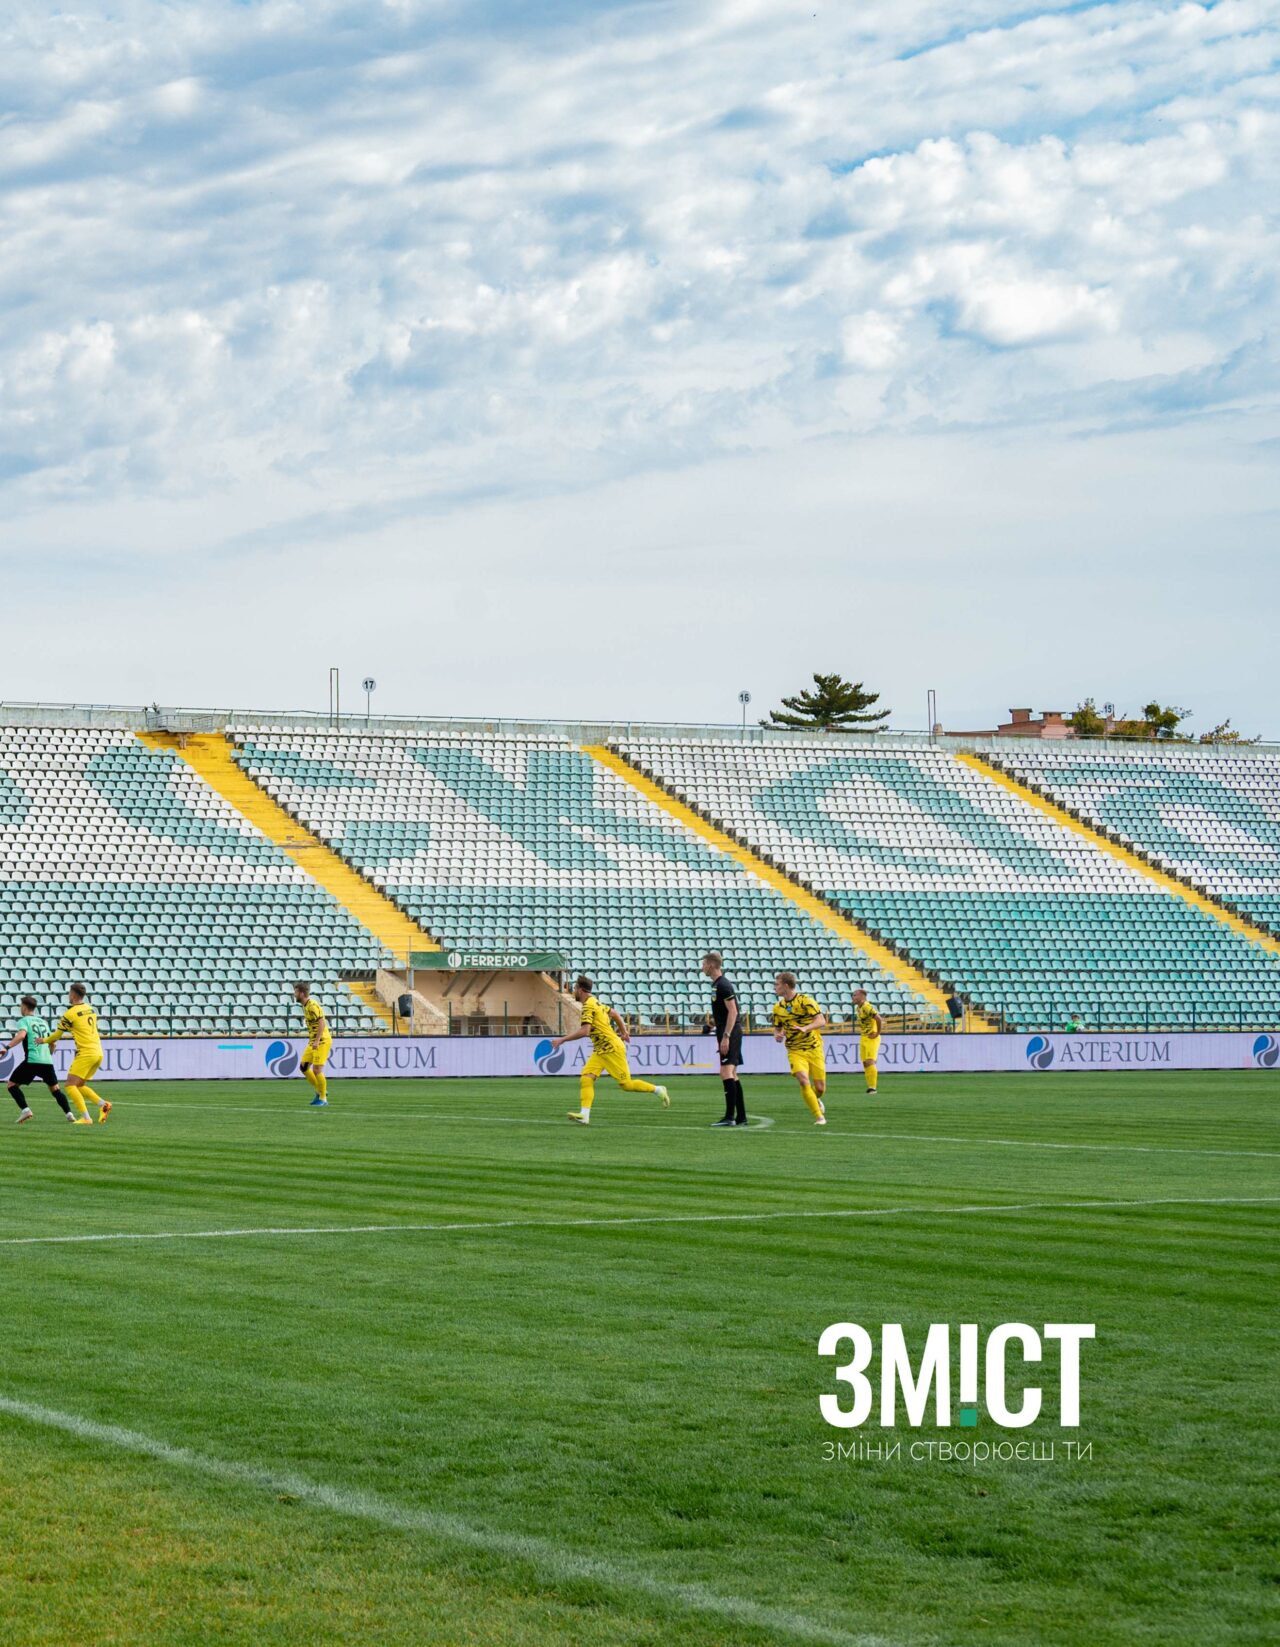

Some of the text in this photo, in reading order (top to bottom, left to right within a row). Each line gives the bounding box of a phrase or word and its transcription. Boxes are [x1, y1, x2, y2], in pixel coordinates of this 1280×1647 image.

[364, 680, 375, 690] 17
[740, 693, 750, 702] 16
[1104, 704, 1113, 713] 15
[463, 955, 528, 967] FERREXPO
[825, 1042, 940, 1064] ARTRIUM
[1060, 1040, 1171, 1062] ARTERIUM
